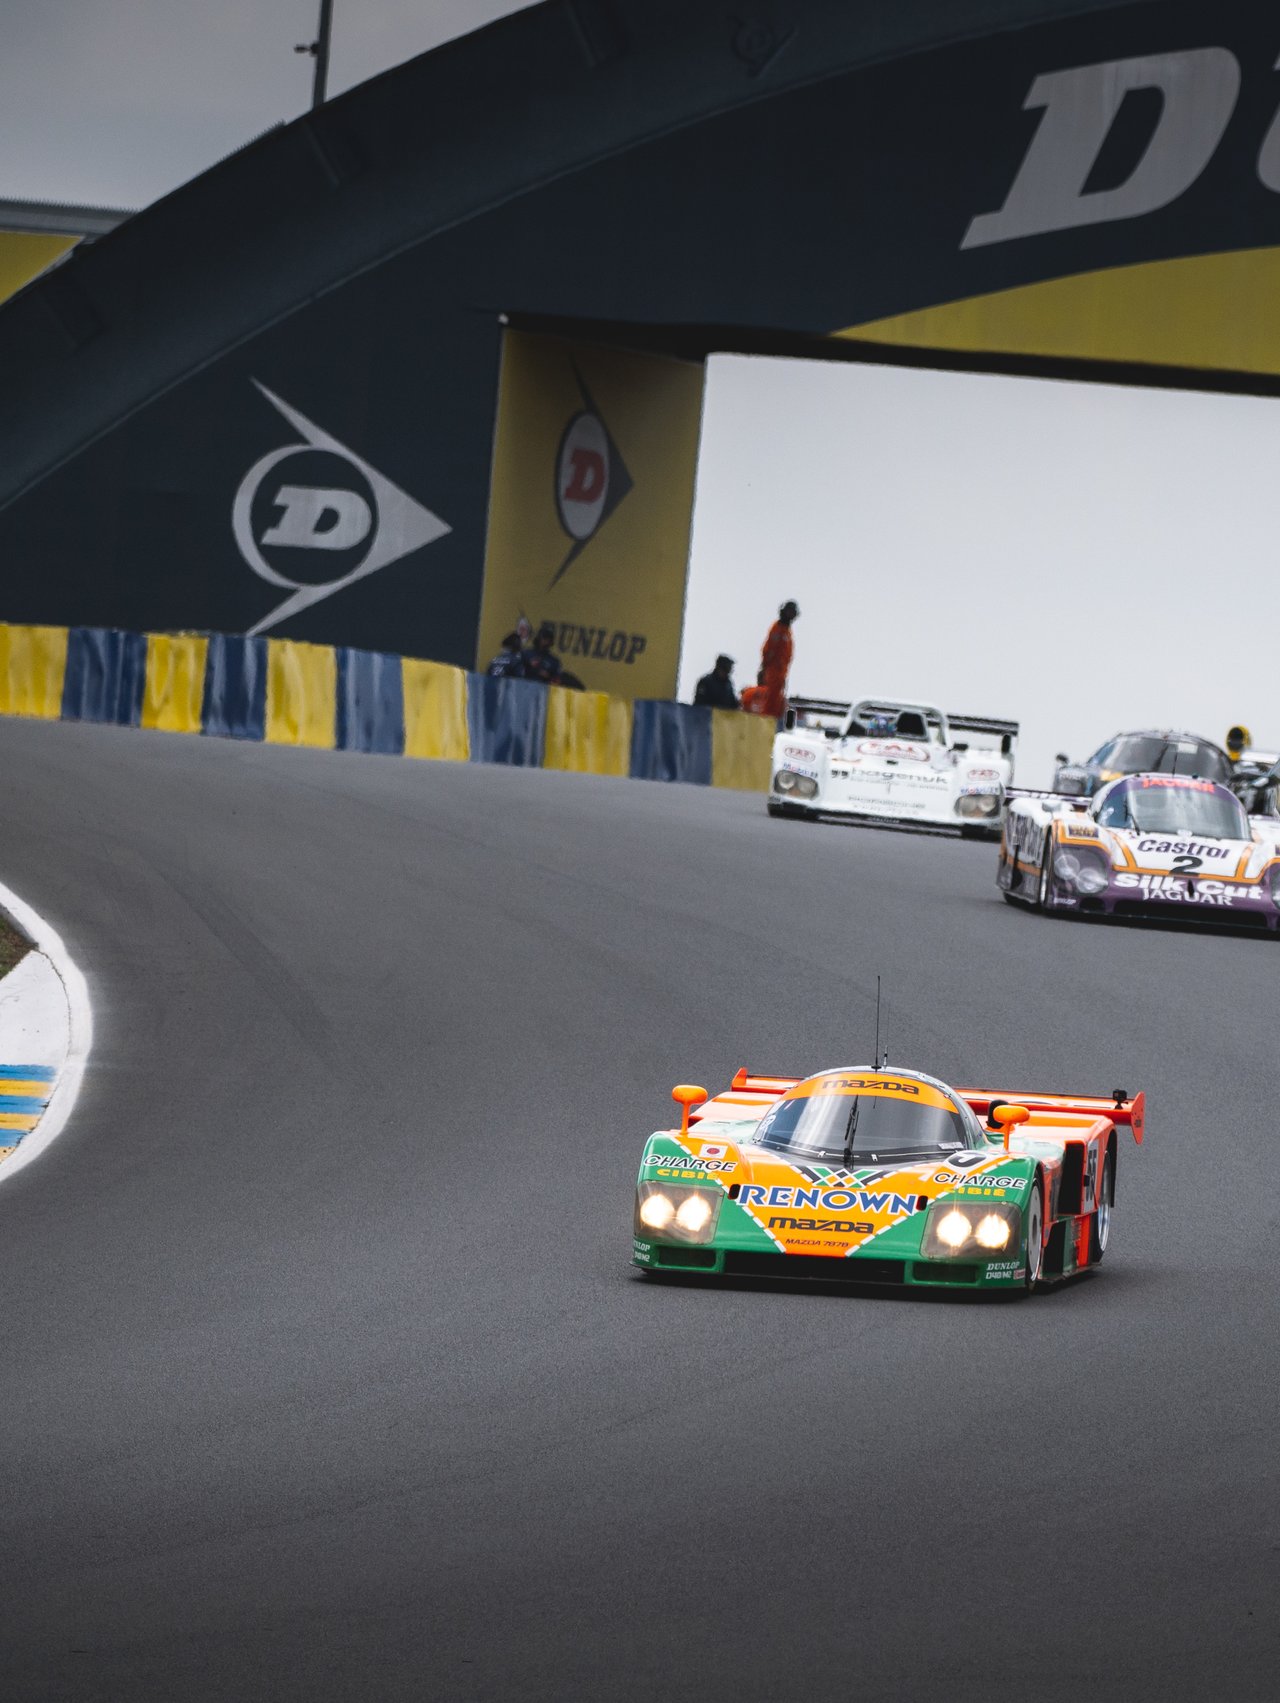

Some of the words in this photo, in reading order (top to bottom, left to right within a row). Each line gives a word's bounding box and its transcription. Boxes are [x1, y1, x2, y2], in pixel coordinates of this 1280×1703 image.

[564, 448, 605, 505] D
[261, 485, 372, 551] D
[1143, 777, 1215, 793] JAGUAR
[1137, 838, 1232, 859] Castrol
[1170, 855, 1203, 876] 2
[1113, 873, 1187, 892] Silk
[1197, 880, 1264, 899] Cut
[1143, 888, 1234, 906] JAGUAR
[822, 1079, 919, 1095] mazda
[645, 1155, 737, 1172] CHARGE
[657, 1168, 718, 1180] CIBIE
[935, 1173, 1027, 1190] CHARGE
[738, 1184, 917, 1215] RENOWN
[768, 1216, 874, 1234] mazda
[785, 1238, 821, 1247] MAZDA
[823, 1240, 849, 1248] 787B
[986, 1261, 1020, 1271] DUNLOP
